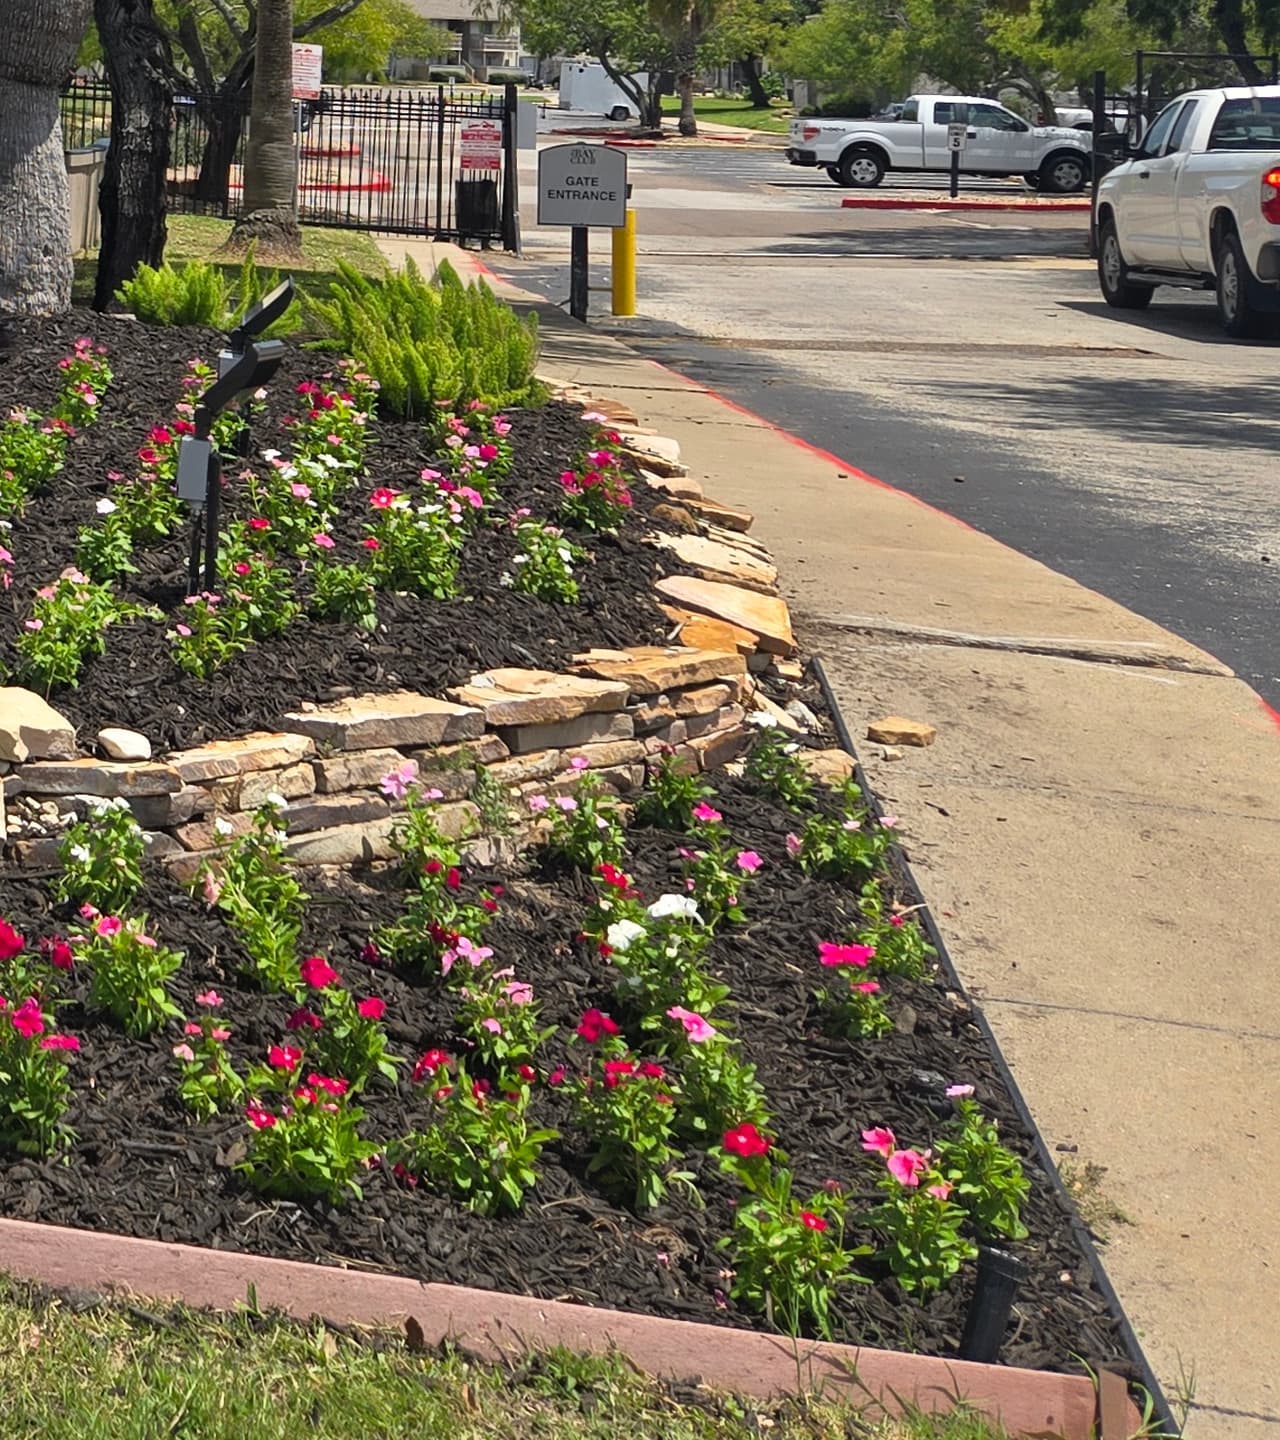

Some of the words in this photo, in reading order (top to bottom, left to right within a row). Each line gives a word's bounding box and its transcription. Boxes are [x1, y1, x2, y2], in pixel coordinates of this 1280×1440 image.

[953, 137, 960, 148] 5
[565, 176, 599, 187] GATE
[547, 189, 617, 201] ENTRANCE
